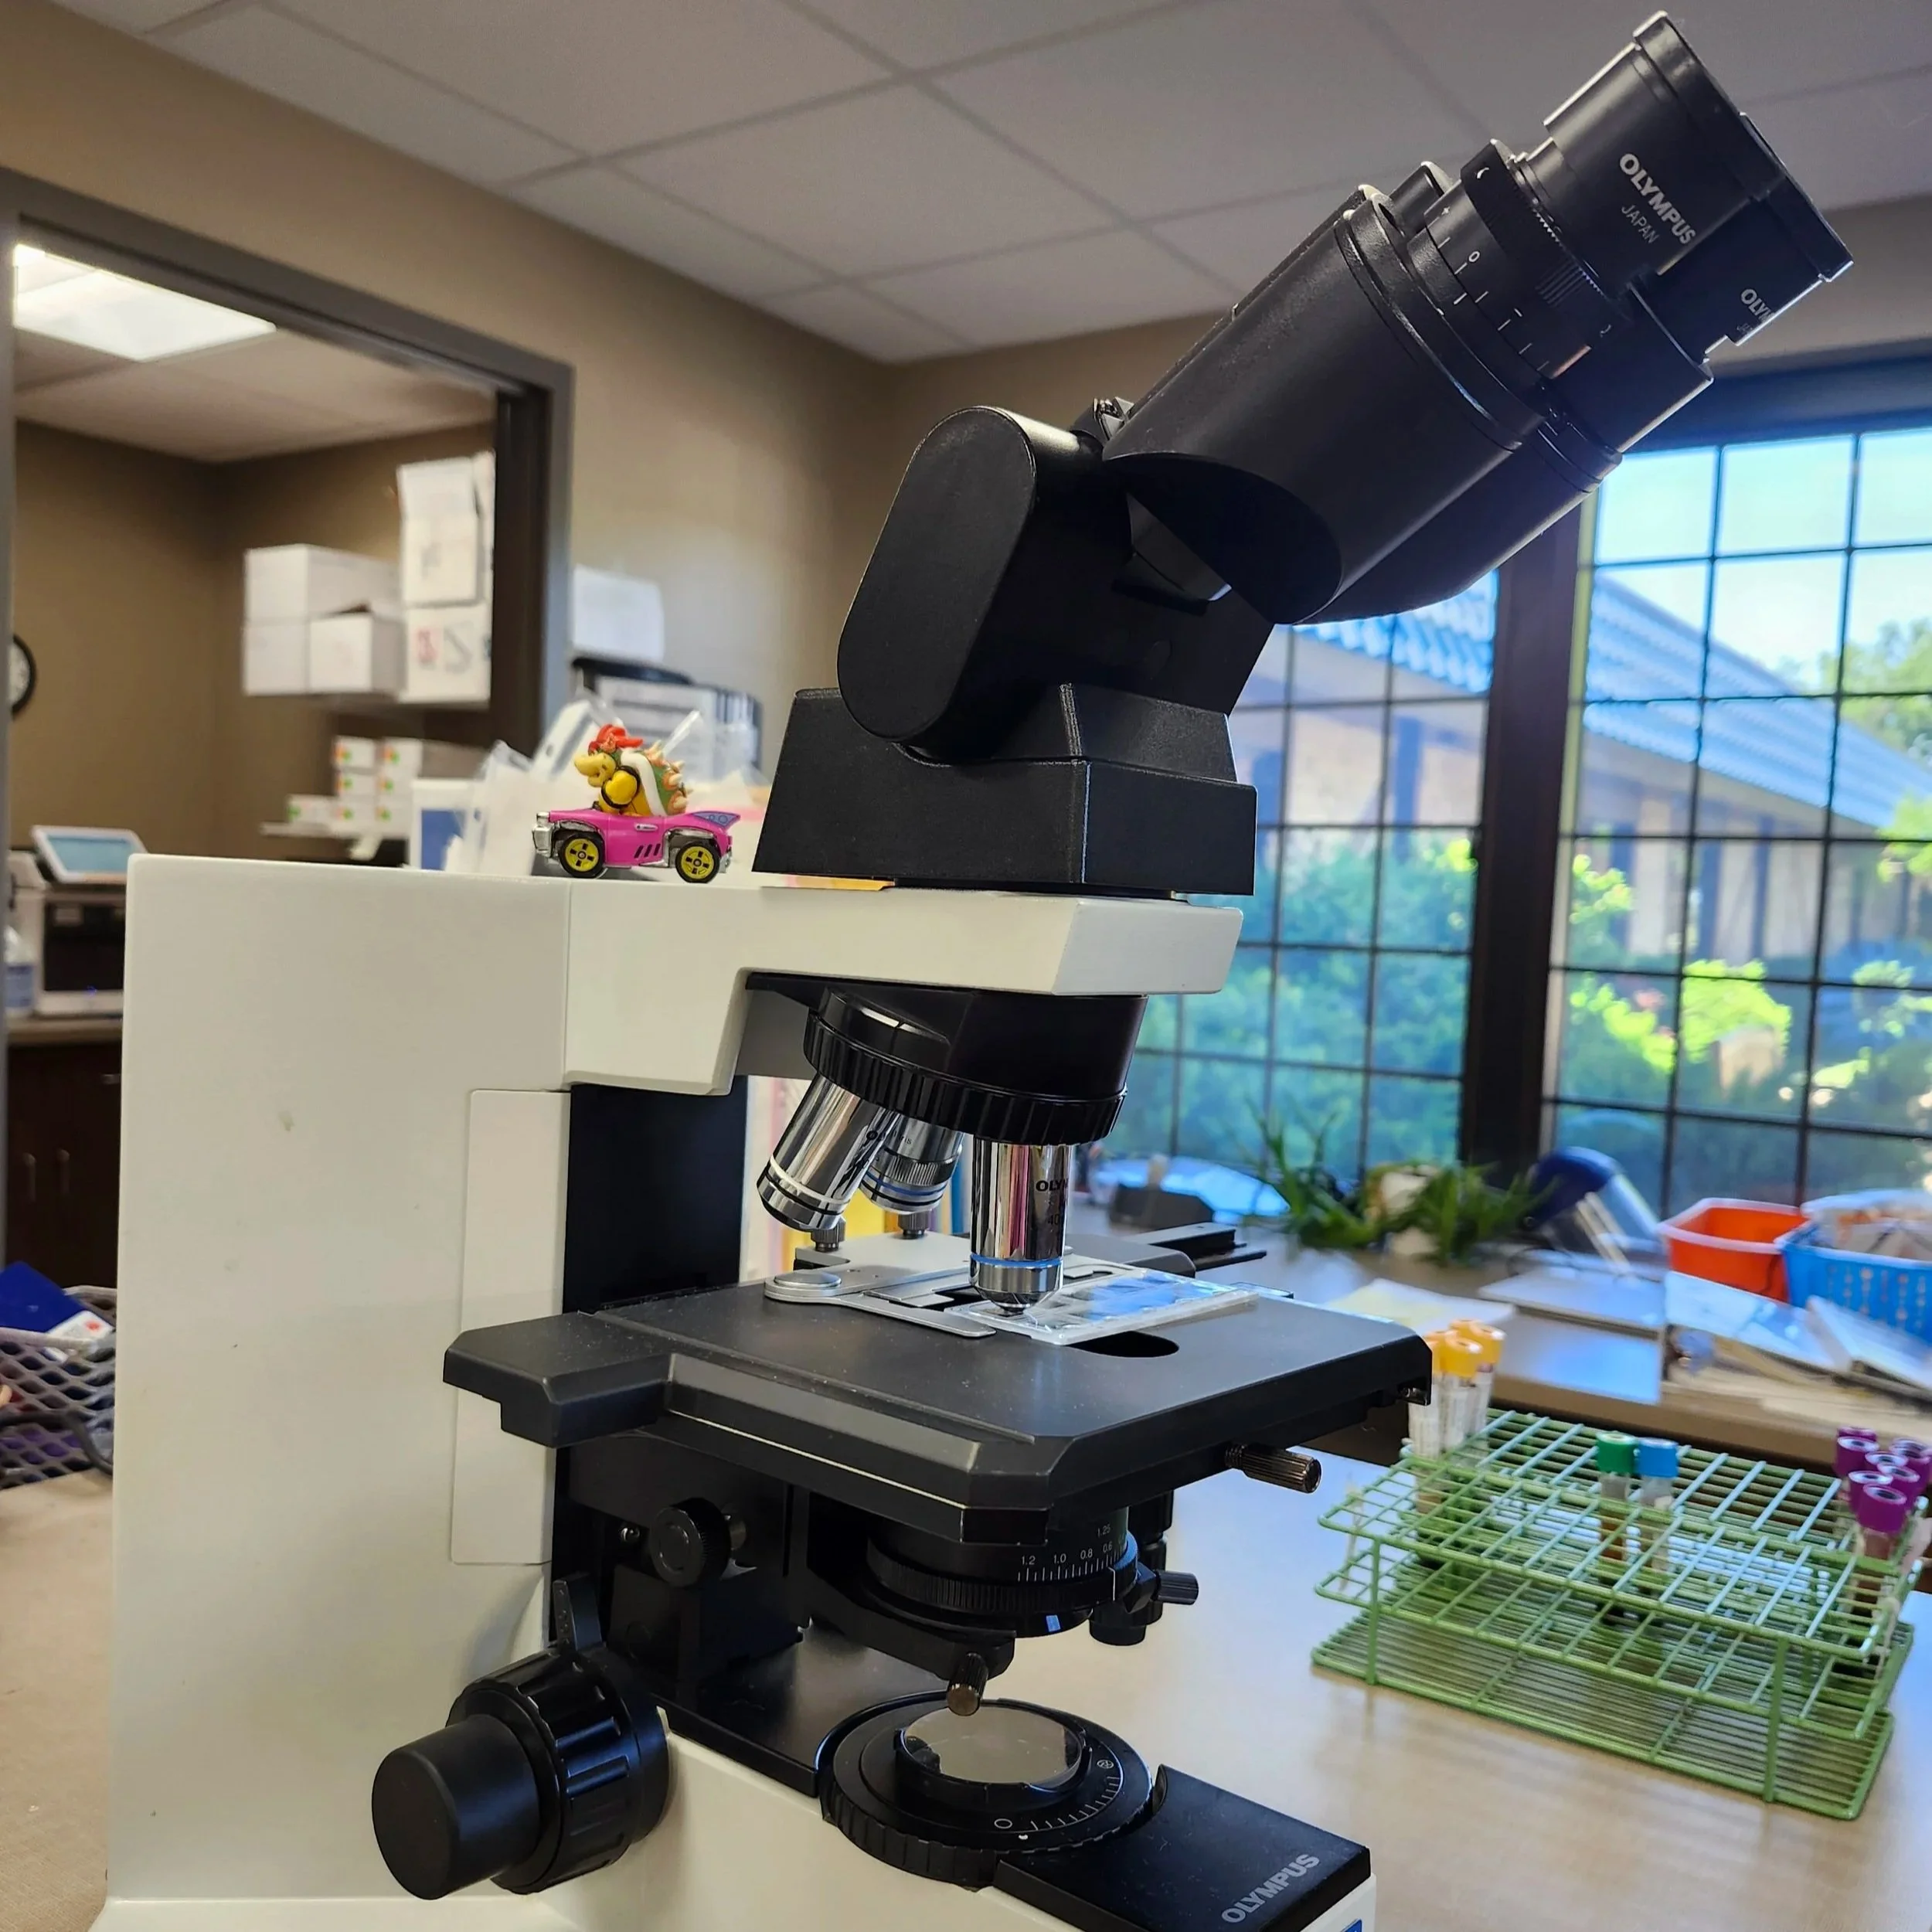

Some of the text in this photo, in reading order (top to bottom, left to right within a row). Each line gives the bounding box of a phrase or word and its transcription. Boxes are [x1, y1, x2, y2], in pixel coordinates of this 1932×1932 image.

[1619, 153, 1696, 244] OLYMPUS
[1621, 204, 1660, 243] JAPAN
[1022, 1541, 1113, 1566] 1.2 1.0 0.8 0.6
[1221, 1854, 1320, 1923] OLYMPUS
